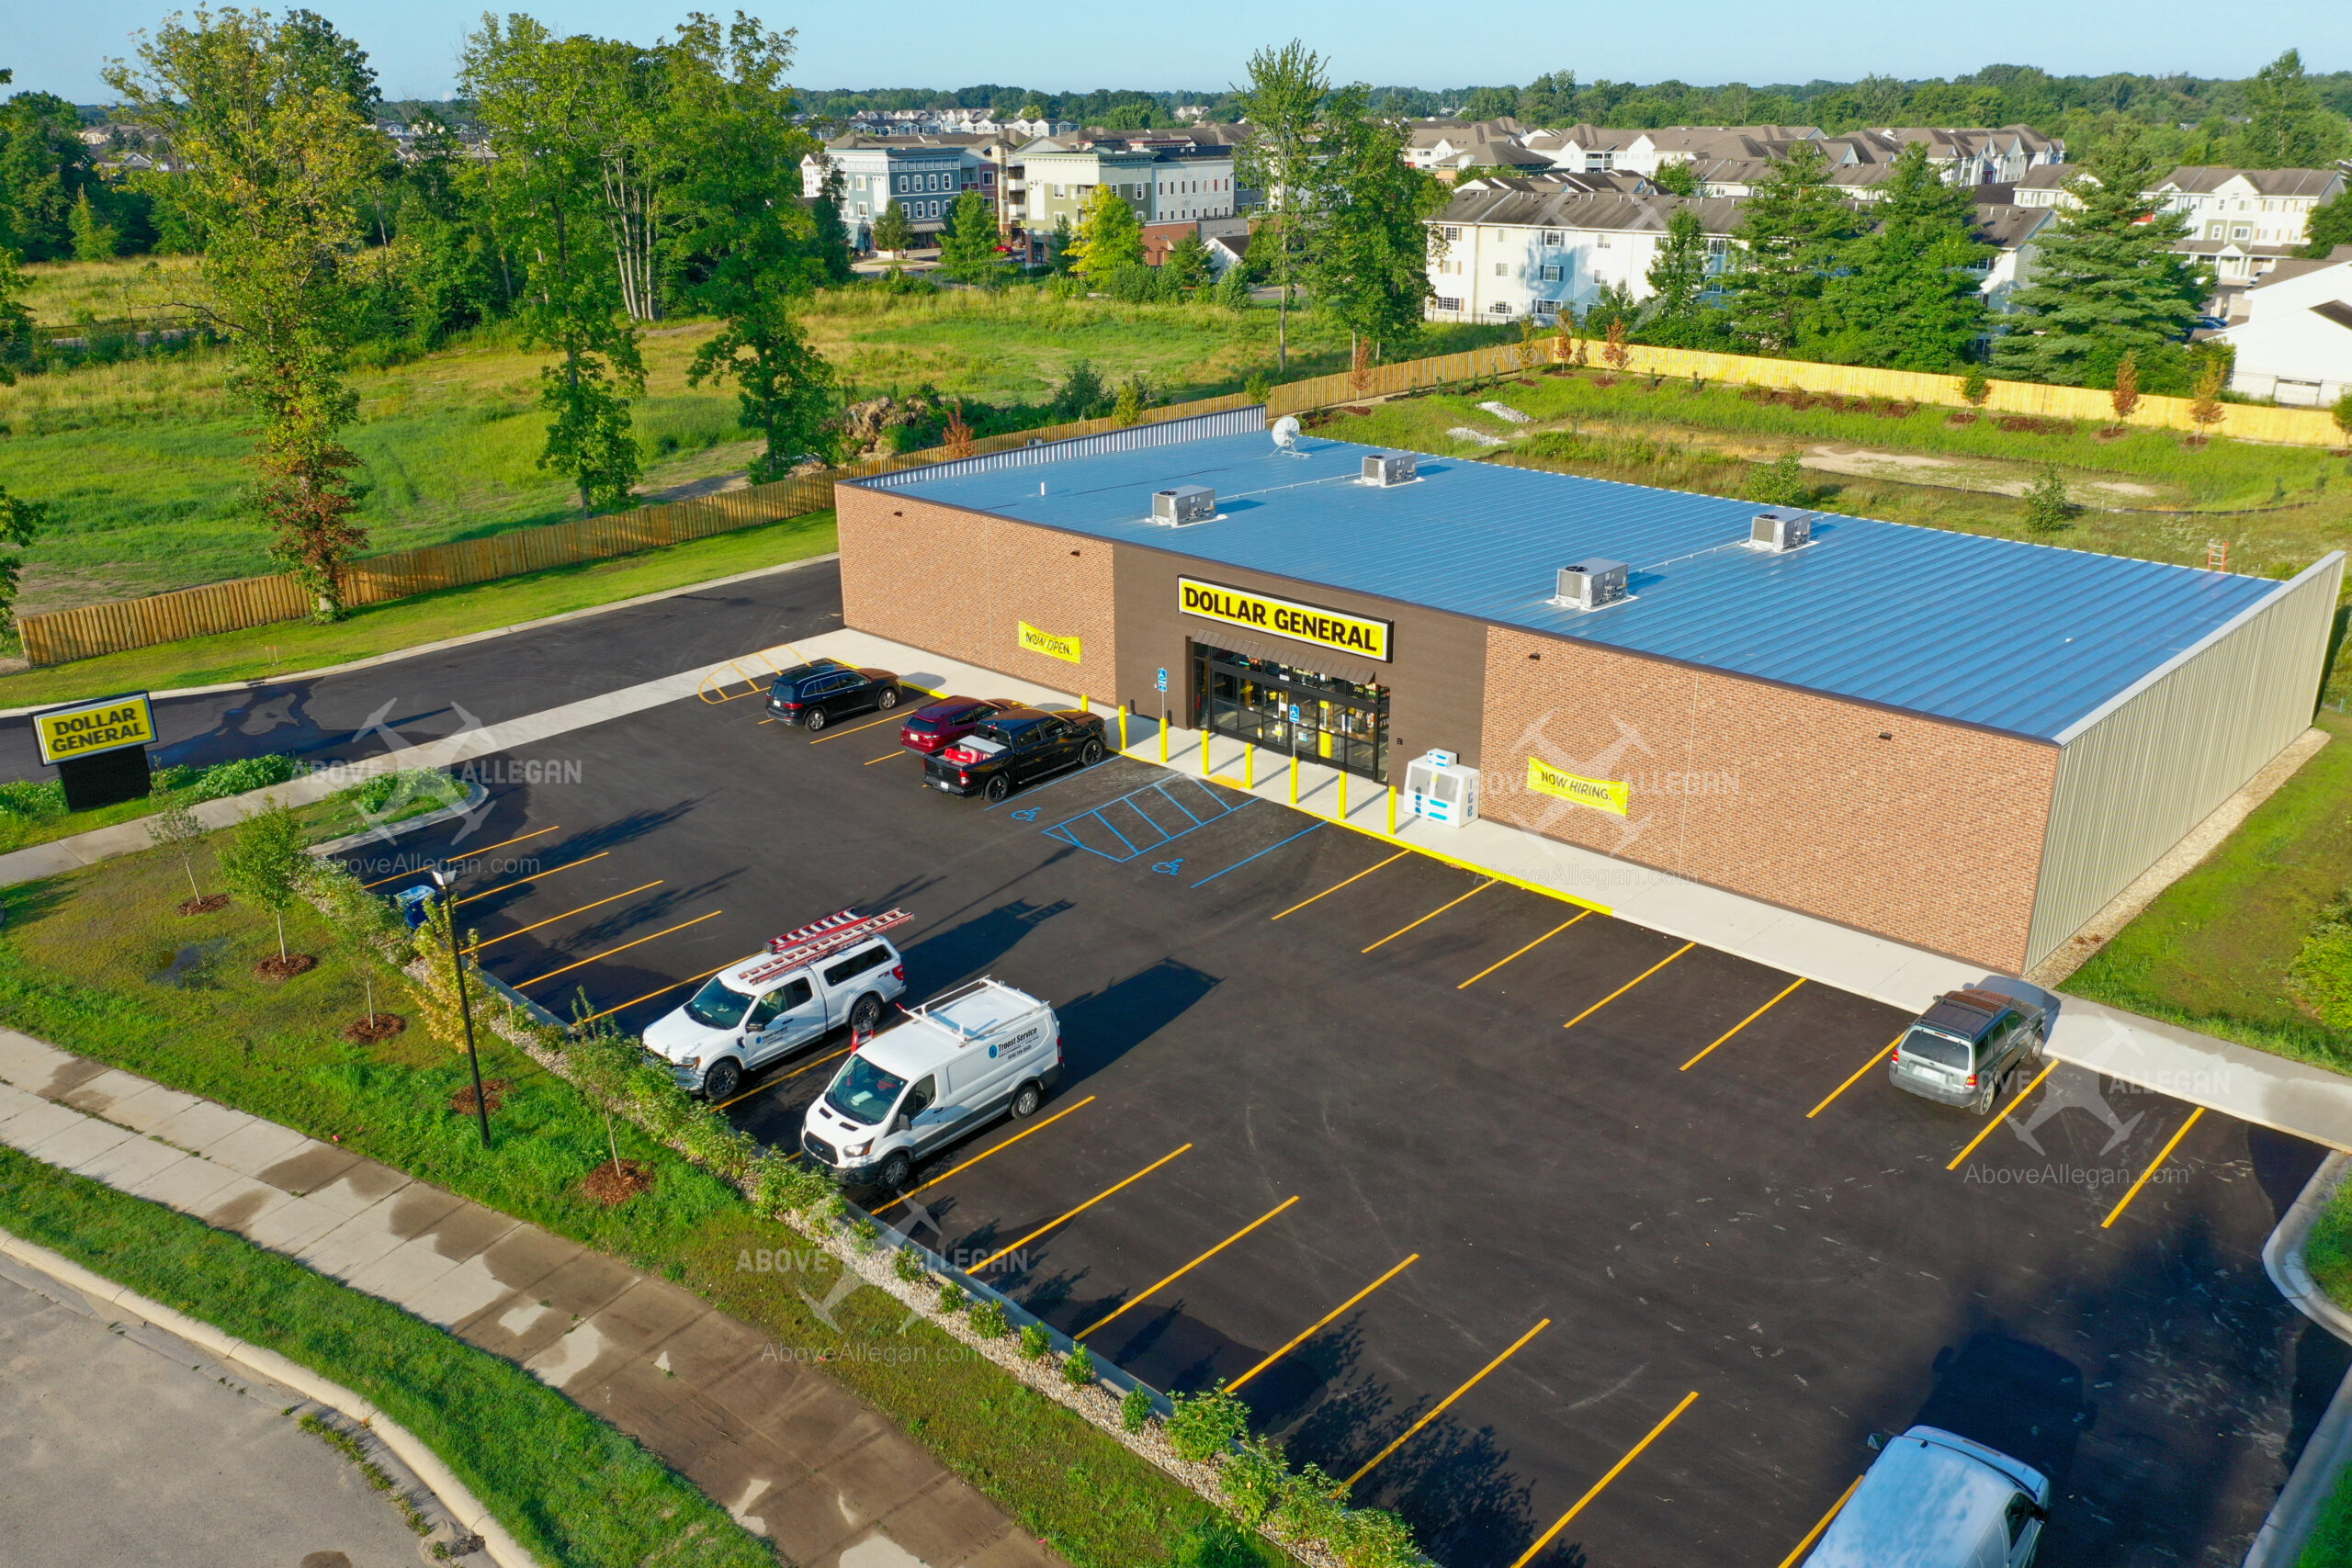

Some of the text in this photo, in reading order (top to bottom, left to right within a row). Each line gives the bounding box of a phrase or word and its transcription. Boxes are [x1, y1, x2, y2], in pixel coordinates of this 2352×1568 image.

[1184, 586, 1376, 651] DOLLAR GENERAL
[1025, 632, 1072, 655] NOW OPEN.
[53, 707, 136, 735] DOLLAR
[51, 723, 145, 752] GENERAL
[1541, 772, 1567, 788] NOW
[1570, 781, 1611, 800] HIRING.
[998, 1037, 1016, 1052] Troost
[1016, 1027, 1037, 1043] Service
